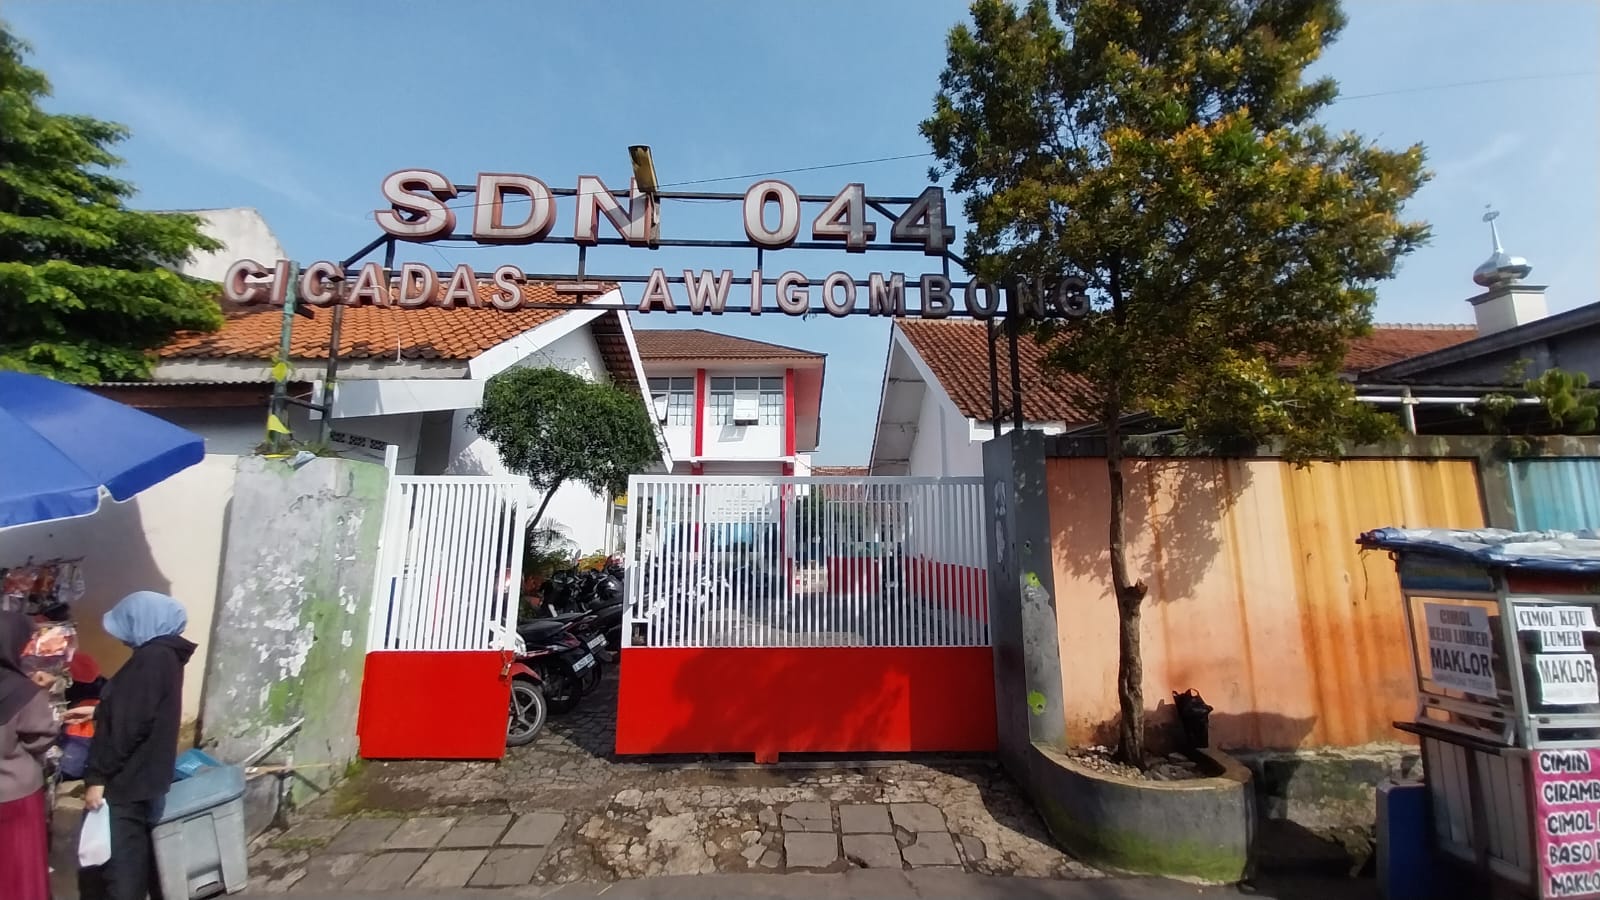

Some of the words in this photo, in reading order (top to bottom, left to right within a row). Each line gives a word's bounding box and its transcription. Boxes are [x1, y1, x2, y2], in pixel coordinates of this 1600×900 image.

[374, 168, 661, 249] SDN
[743, 179, 956, 256] 044
[224, 258, 528, 311] CICADAS
[638, 266, 1092, 321] AWIGOMBONG
[1439, 609, 1473, 627] CIMOL
[1519, 610, 1556, 627] CIMOL
[1558, 610, 1587, 628] KEJU
[1453, 629, 1489, 648] LUMER
[1543, 631, 1582, 647] LUMER
[1430, 647, 1492, 679] MAKLOR
[1538, 659, 1596, 684] MAKLOR
[1540, 753, 1590, 772] CIMIN
[1547, 812, 1594, 834] CIMOL
[1550, 844, 1592, 865] BASO
